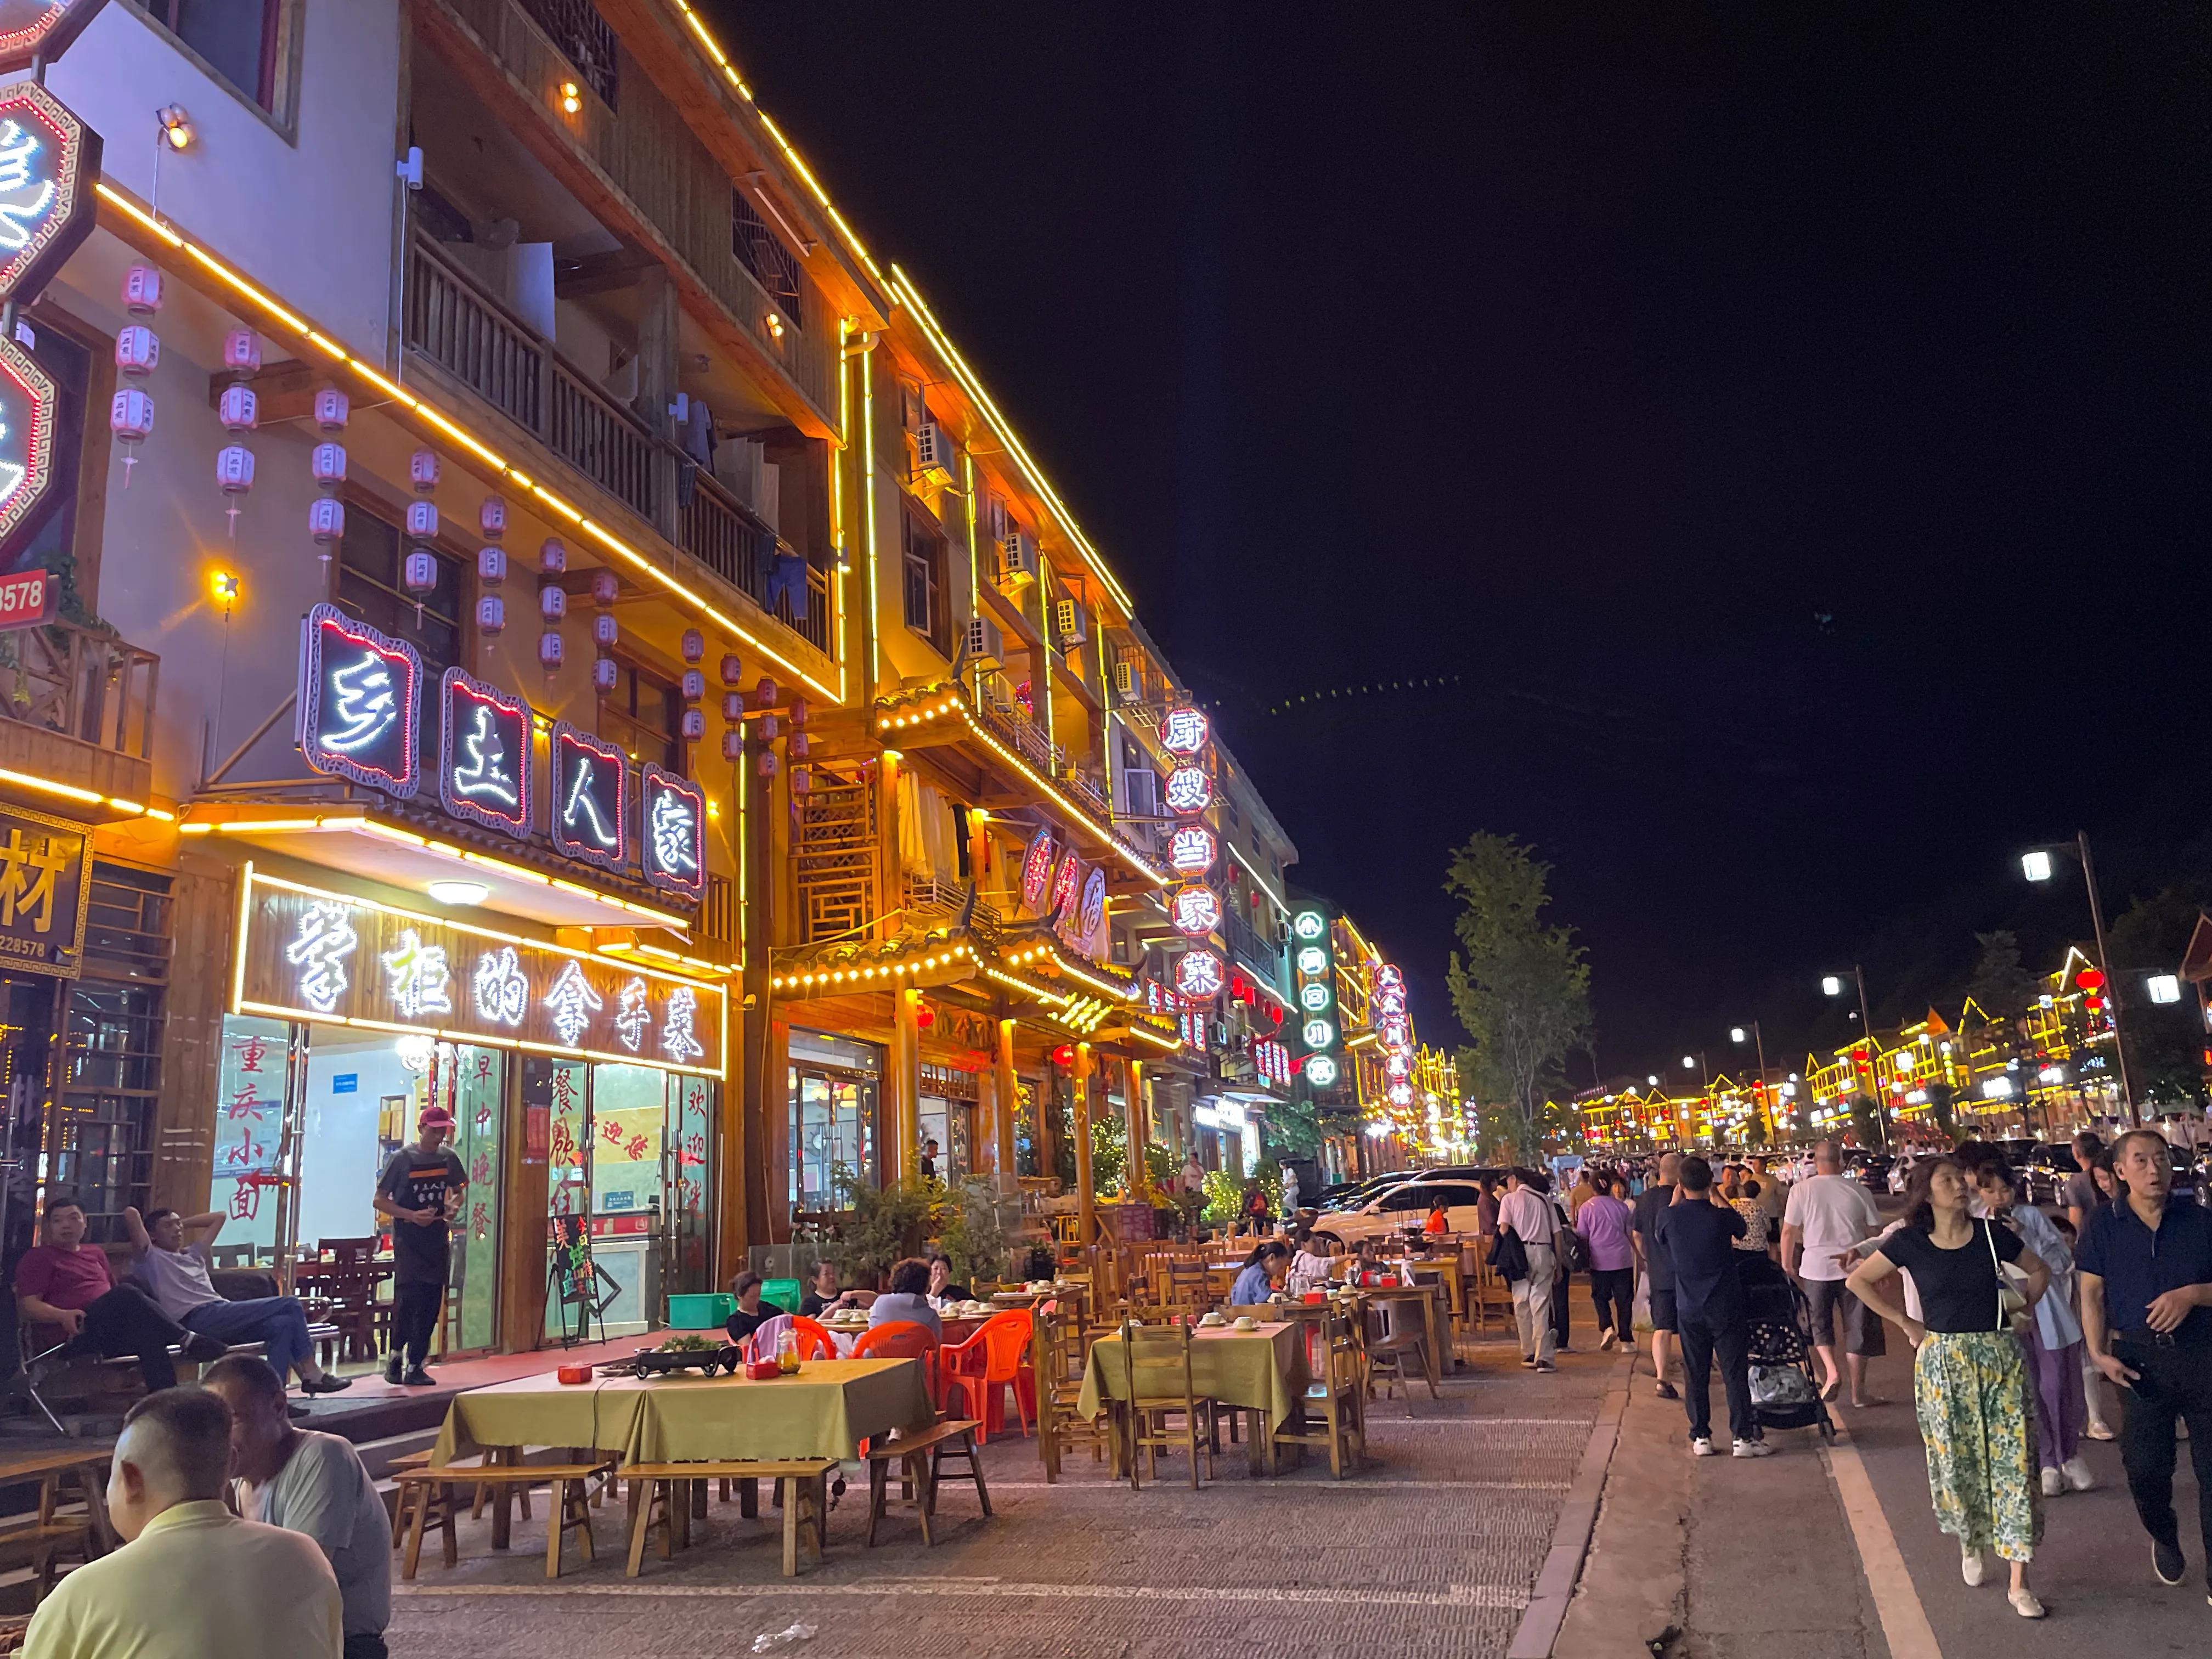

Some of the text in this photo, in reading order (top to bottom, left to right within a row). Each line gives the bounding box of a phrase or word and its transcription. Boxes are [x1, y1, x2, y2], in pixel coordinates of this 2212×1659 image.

[0, 828, 65, 932] 材
[1165, 713, 1219, 992] 厨嫂当家菜
[287, 900, 704, 1063] 掌柜的拿手菜
[228, 1035, 267, 1221] 重庆小面
[470, 1055, 493, 1241] 早中晚餐
[550, 1068, 578, 1216] 餐饮住
[687, 1084, 707, 1268] 欢迎光
